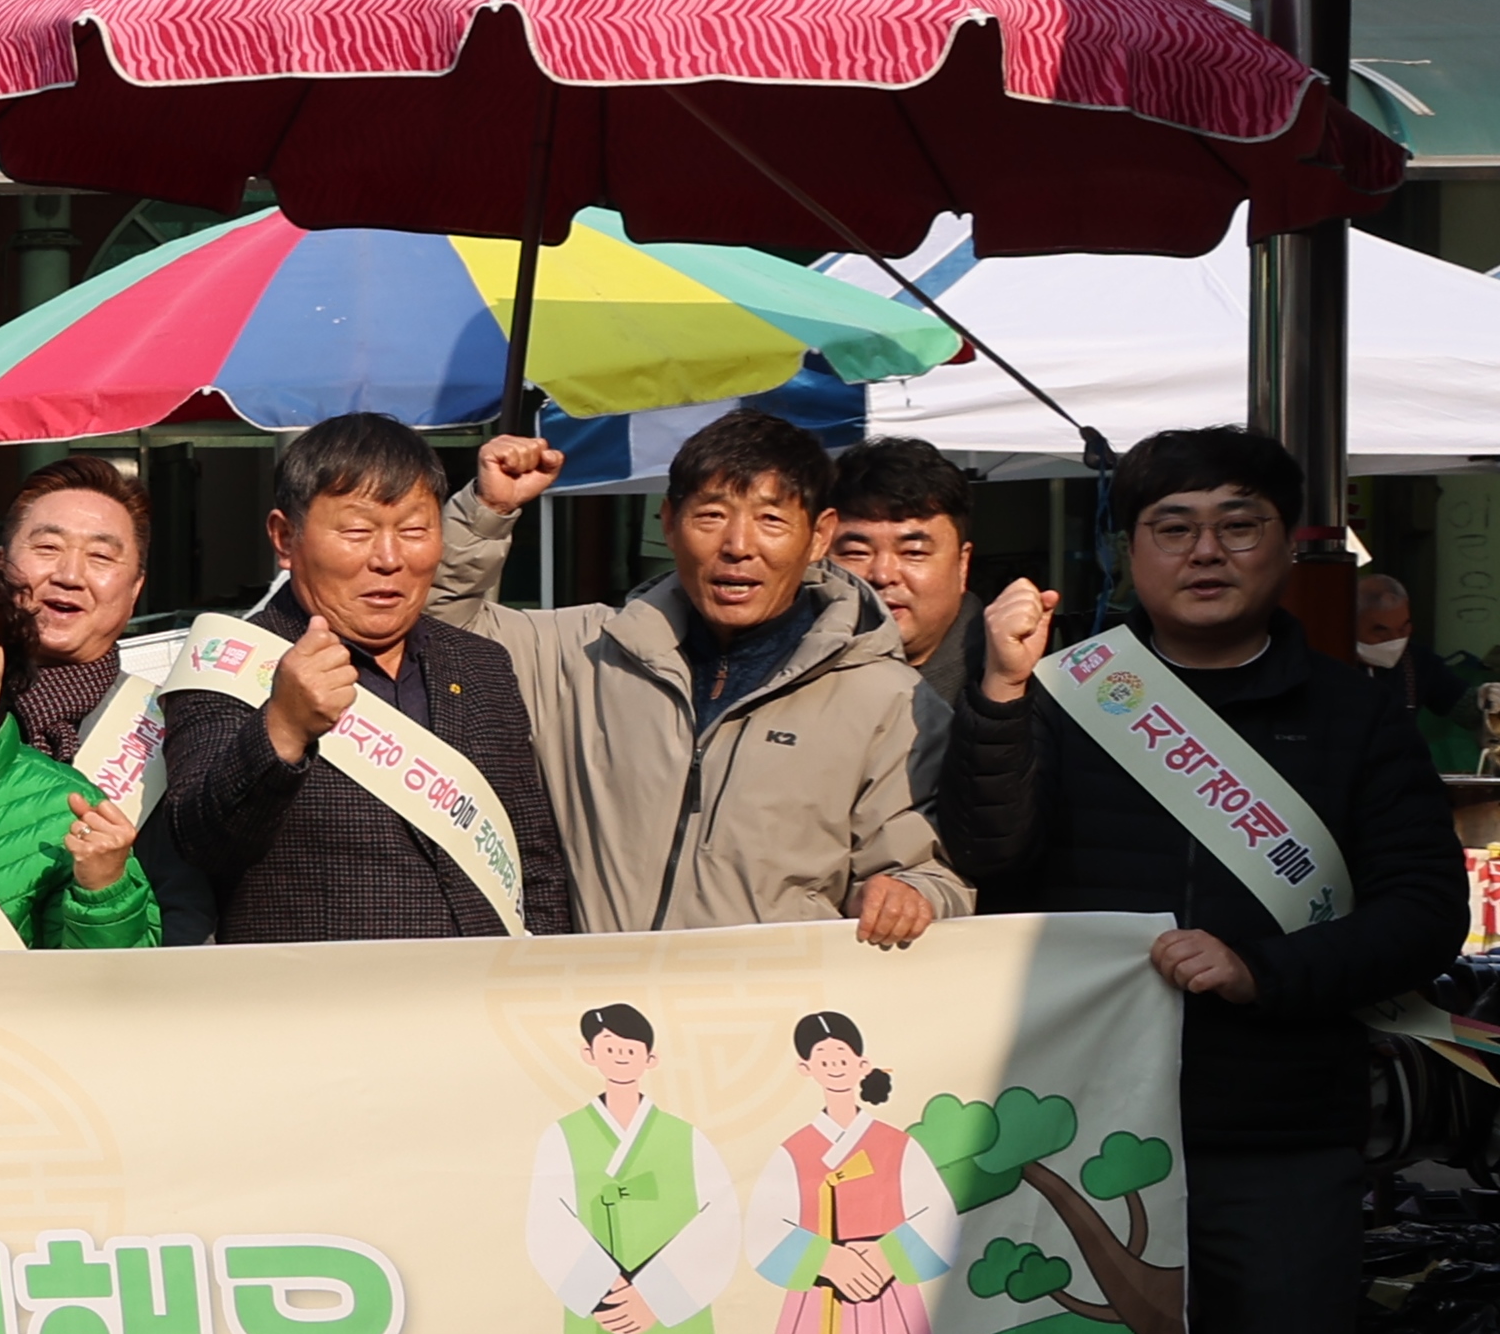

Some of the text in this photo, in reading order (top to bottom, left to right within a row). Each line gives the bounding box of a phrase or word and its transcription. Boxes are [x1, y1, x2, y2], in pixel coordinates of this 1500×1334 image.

[96, 714, 167, 802] 전통시장
[765, 730, 797, 746] K2
[404, 758, 478, 830] 이용을
[474, 819, 517, 897] 생활화
[1130, 704, 1316, 886] 지역경제를
